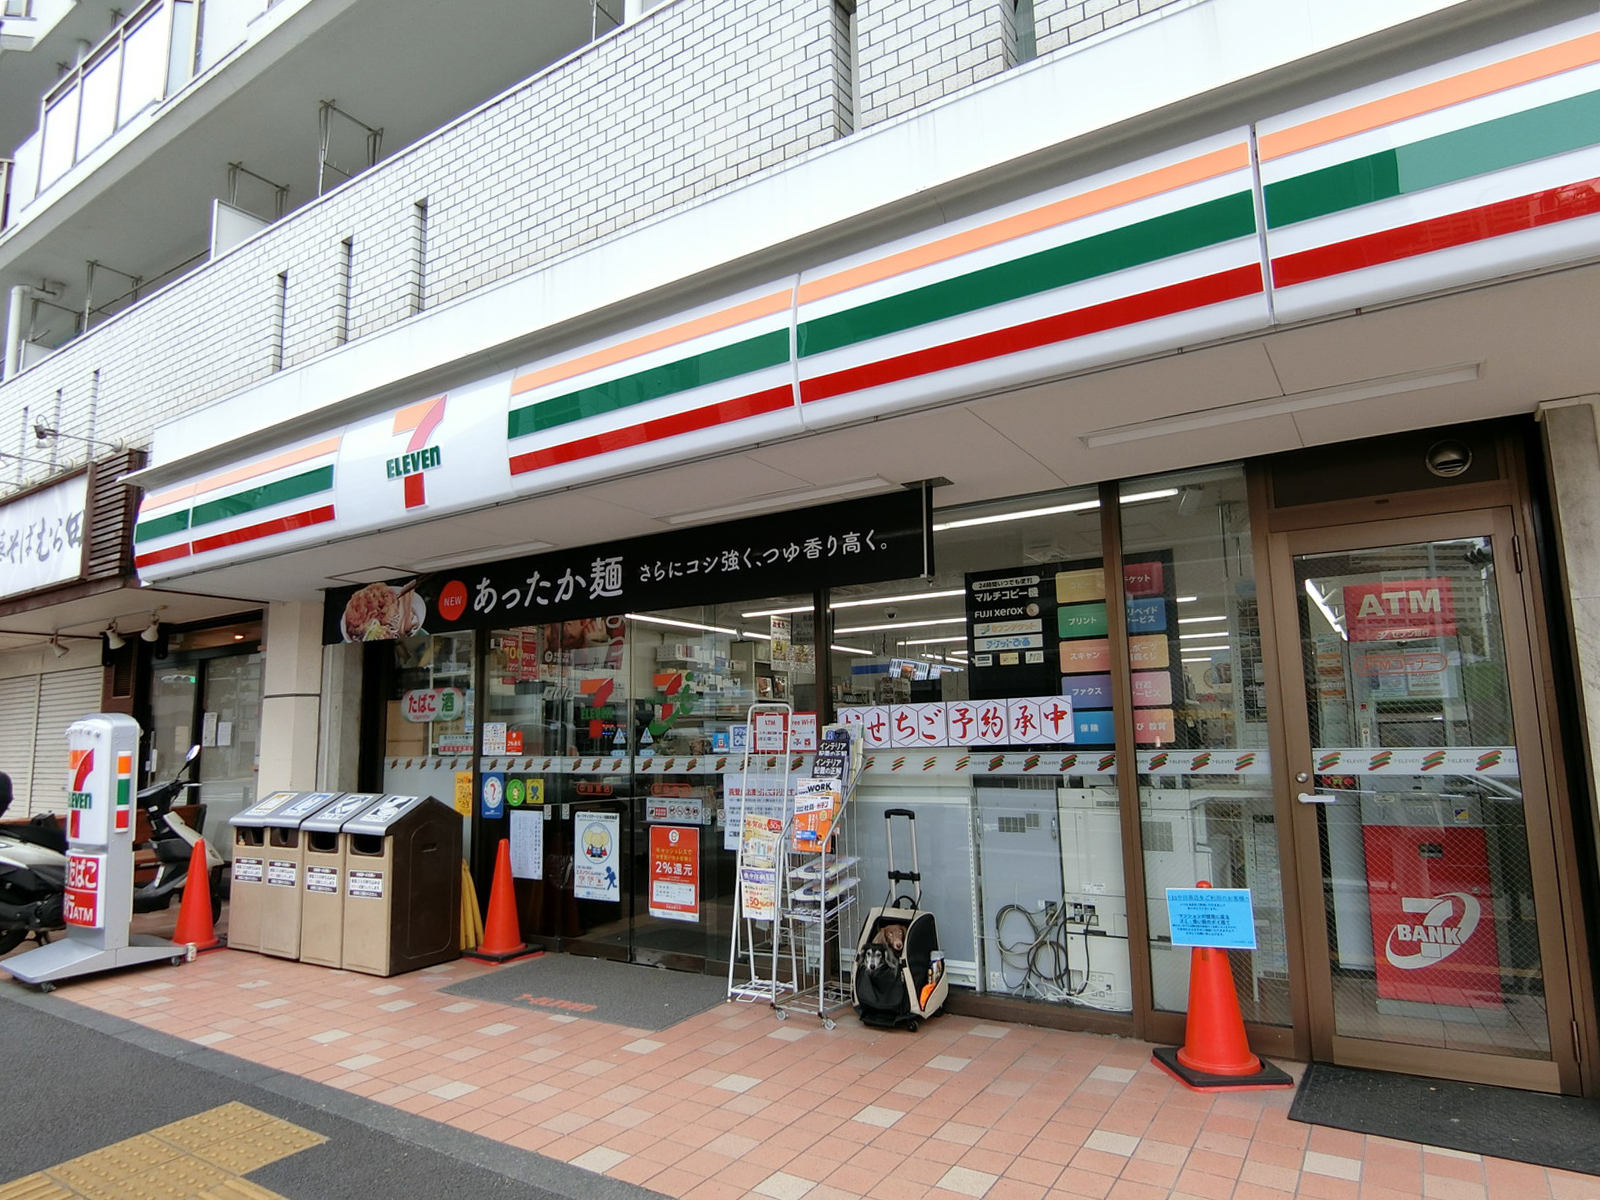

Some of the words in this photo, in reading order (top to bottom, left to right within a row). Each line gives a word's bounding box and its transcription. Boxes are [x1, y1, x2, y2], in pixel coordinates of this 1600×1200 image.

[639, 529, 888, 582] さらにコシ強く、つゆ香り高く。
[473, 556, 624, 614] あったか麺
[974, 587, 1039, 602] マルチコピー機
[443, 595, 463, 607] NEW
[1358, 588, 1441, 618] ATM
[974, 610, 993, 619] FUJI
[1127, 616, 1156, 624] ービス
[1068, 617, 1097, 625] プリント
[1070, 651, 1100, 660] スキャン
[1072, 687, 1103, 696] ファクス
[408, 693, 436, 713] たばこ
[441, 692, 455, 712] 酒
[1080, 724, 1099, 732] 保険
[820, 742, 847, 751] インテリア
[815, 758, 842, 767] インテリア
[807, 782, 832, 793] WORK
[655, 861, 693, 876] 2%還元
[1397, 924, 1462, 945] BANK
